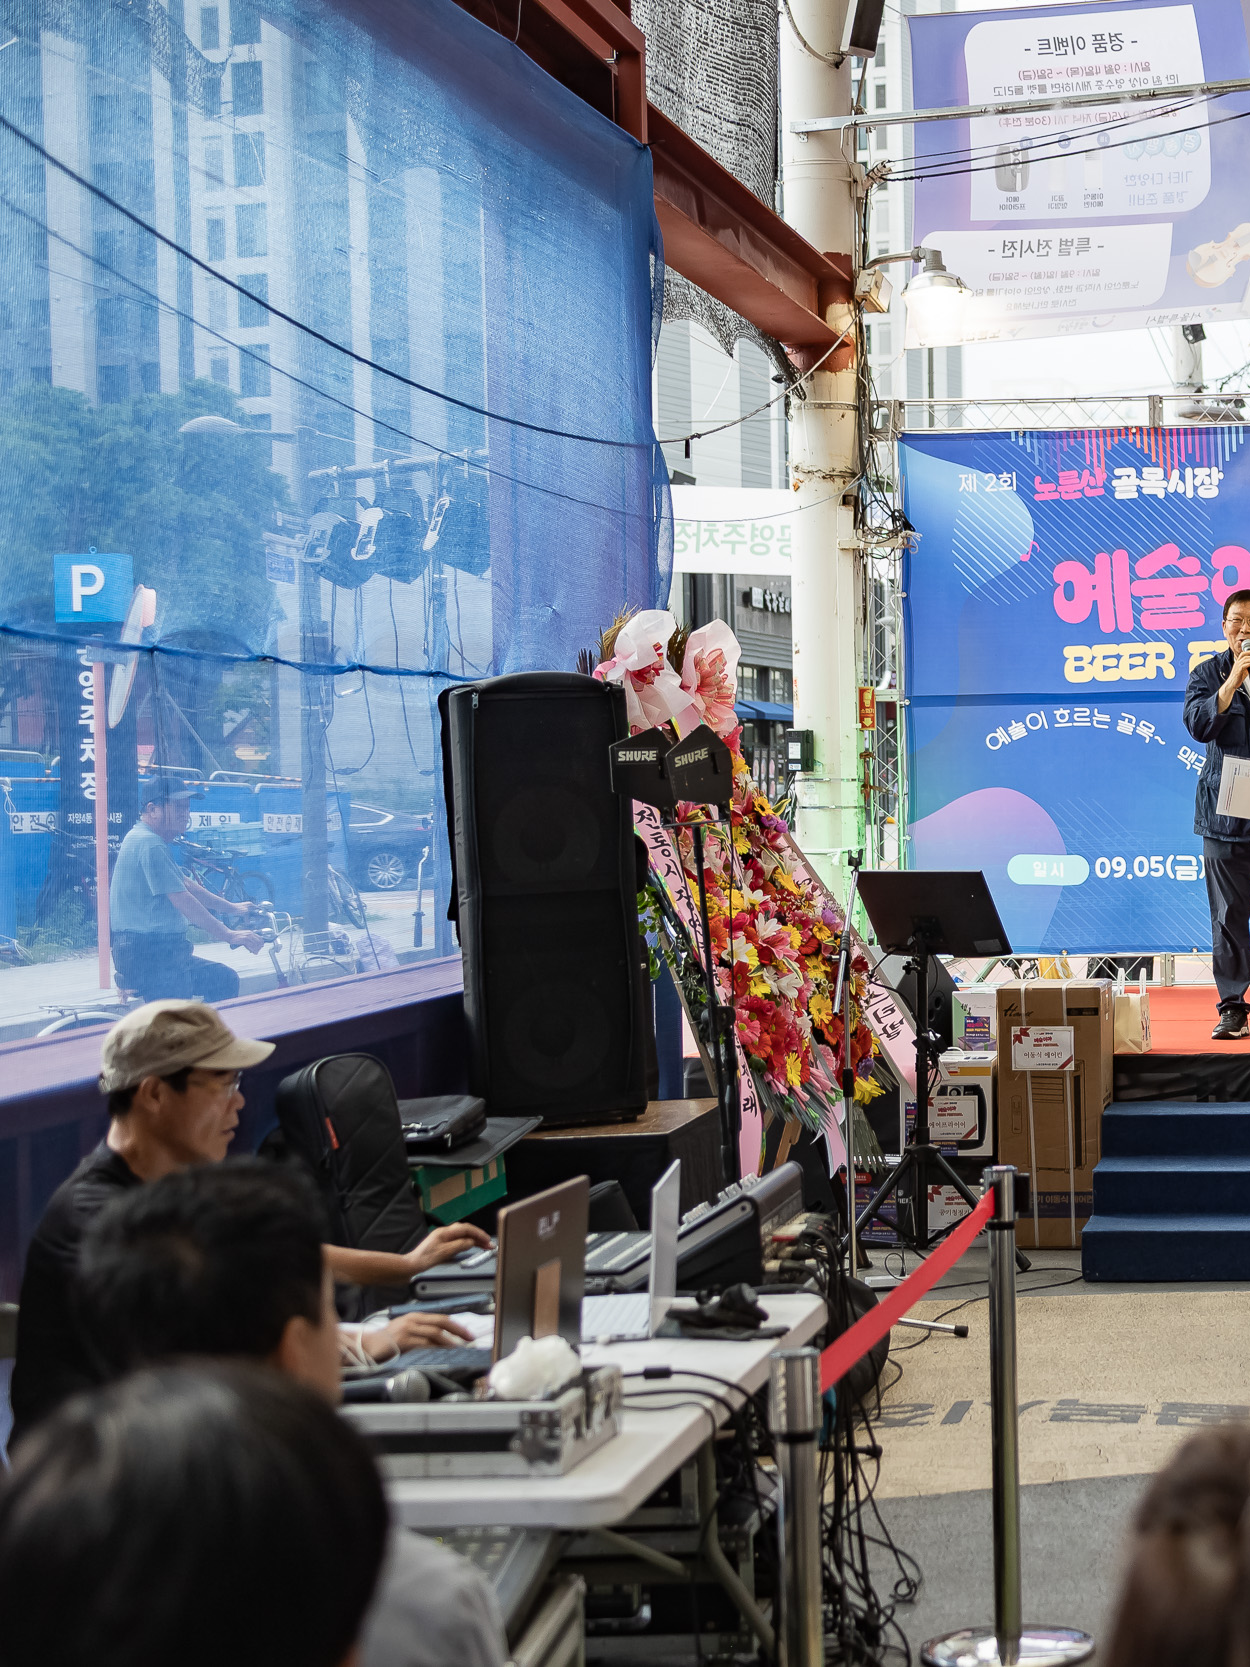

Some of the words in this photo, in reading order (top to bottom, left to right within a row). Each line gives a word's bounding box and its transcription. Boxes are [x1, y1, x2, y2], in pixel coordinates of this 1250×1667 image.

[958, 473, 979, 494] 제
[984, 471, 1017, 494] 2회
[1033, 467, 1106, 501] 노룬산
[1111, 466, 1224, 500] 골목시장
[70, 565, 105, 612] P
[1063, 642, 1175, 683] BEER
[986, 710, 1048, 750] 예술이
[1054, 708, 1111, 729] 흐르는
[618, 750, 657, 762] SHURE
[674, 747, 709, 768] SHURE
[1032, 861, 1065, 878] 일시
[1094, 854, 1205, 882] 09.05(금)
